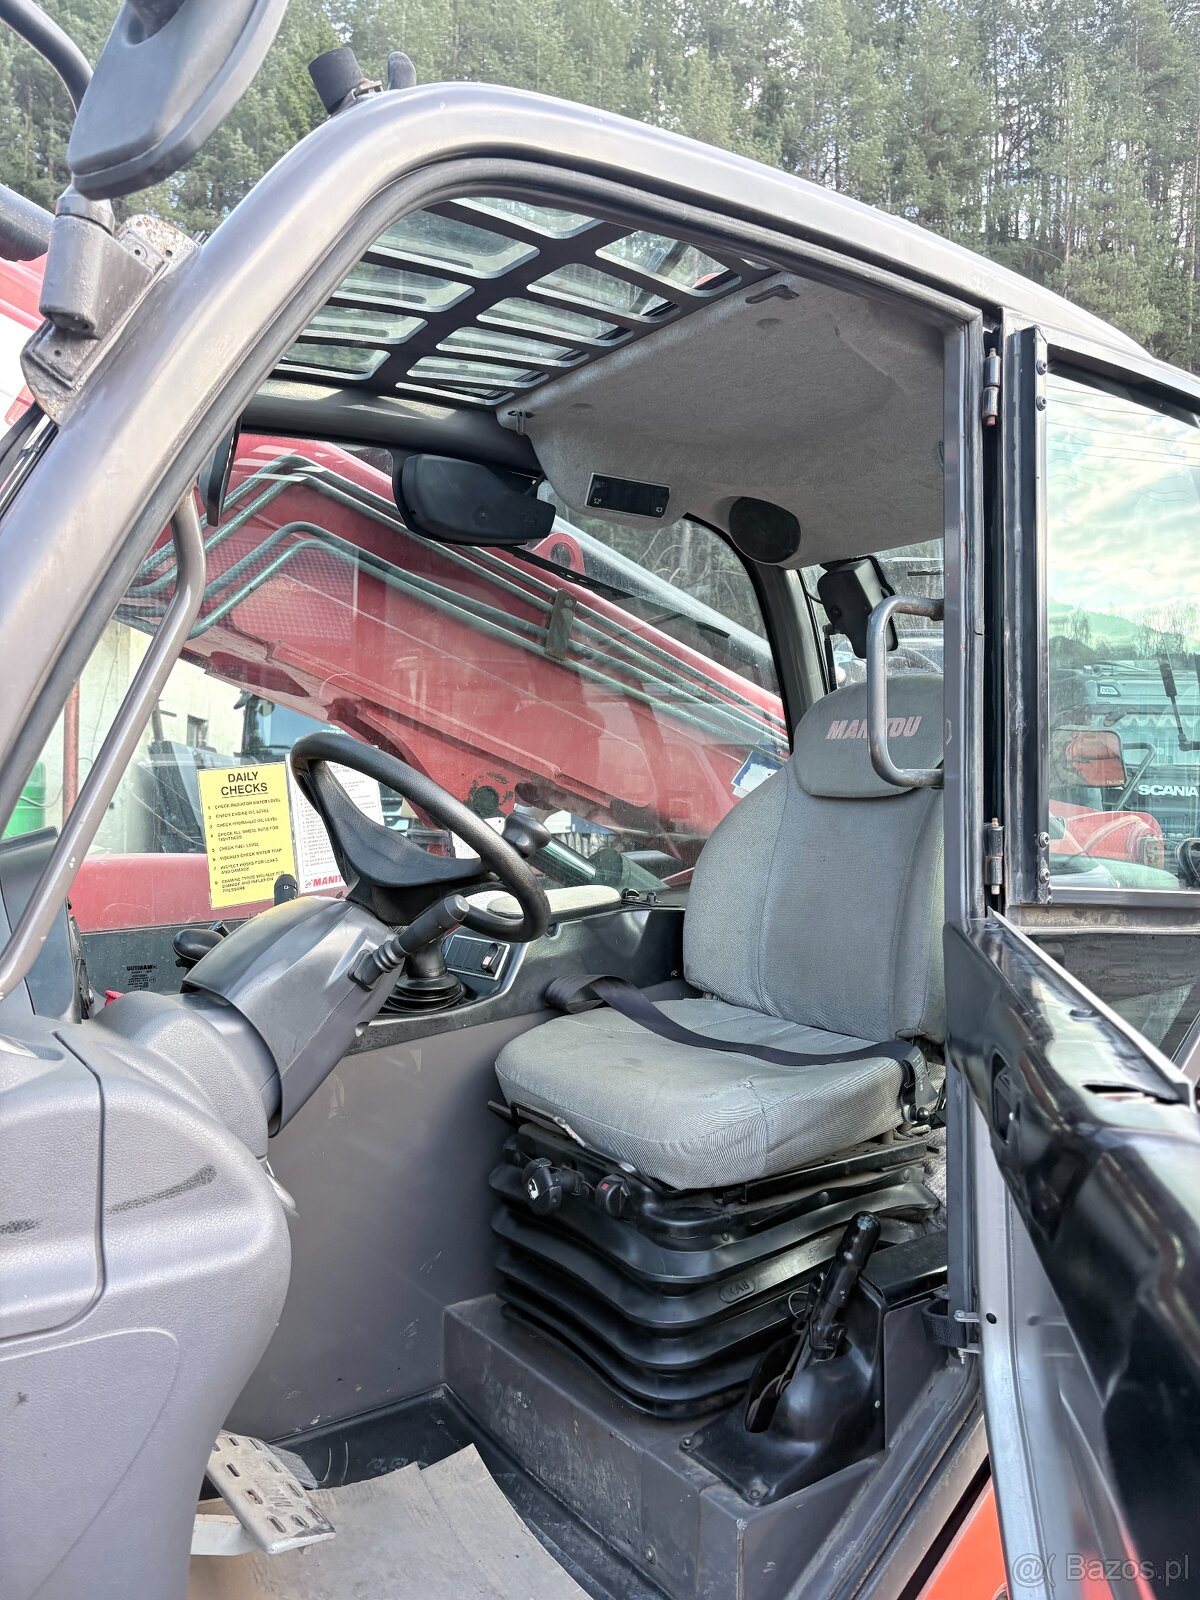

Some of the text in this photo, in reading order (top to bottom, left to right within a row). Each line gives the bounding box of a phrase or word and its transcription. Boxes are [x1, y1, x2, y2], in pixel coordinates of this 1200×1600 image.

[228, 771, 258, 783] DAILY
[221, 782, 268, 796] CHECKS
[1138, 785, 1199, 797] SCANIA
[313, 875, 343, 887] MANIT
